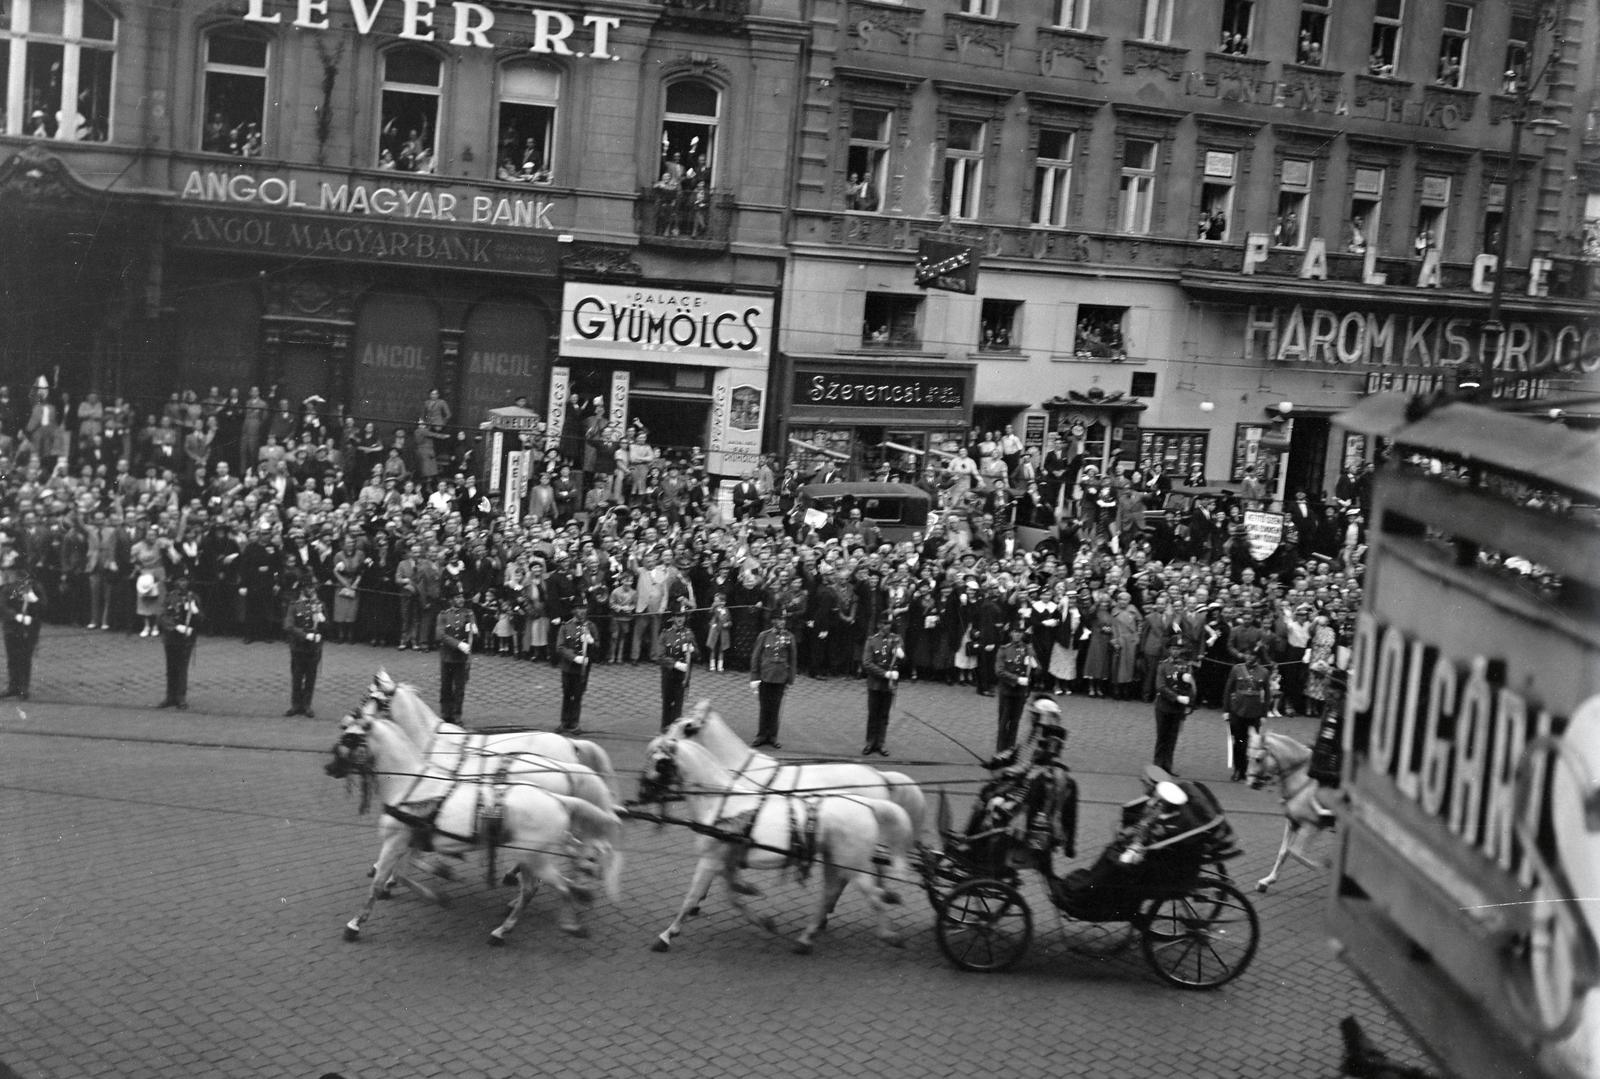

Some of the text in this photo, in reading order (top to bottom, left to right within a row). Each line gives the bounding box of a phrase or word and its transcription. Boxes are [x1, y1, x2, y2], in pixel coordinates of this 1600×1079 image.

[244, 0, 495, 48] LEVER
[181, 170, 555, 229] ANGOL MAGYAR BANK
[183, 216, 276, 246] ANGOL
[1242, 232, 1553, 298] PALACE
[573, 296, 761, 351] GYÜMÖLCS
[633, 292, 702, 308] PALACE
[1402, 315, 1472, 368] KIS
[811, 375, 922, 403] Szerencsi
